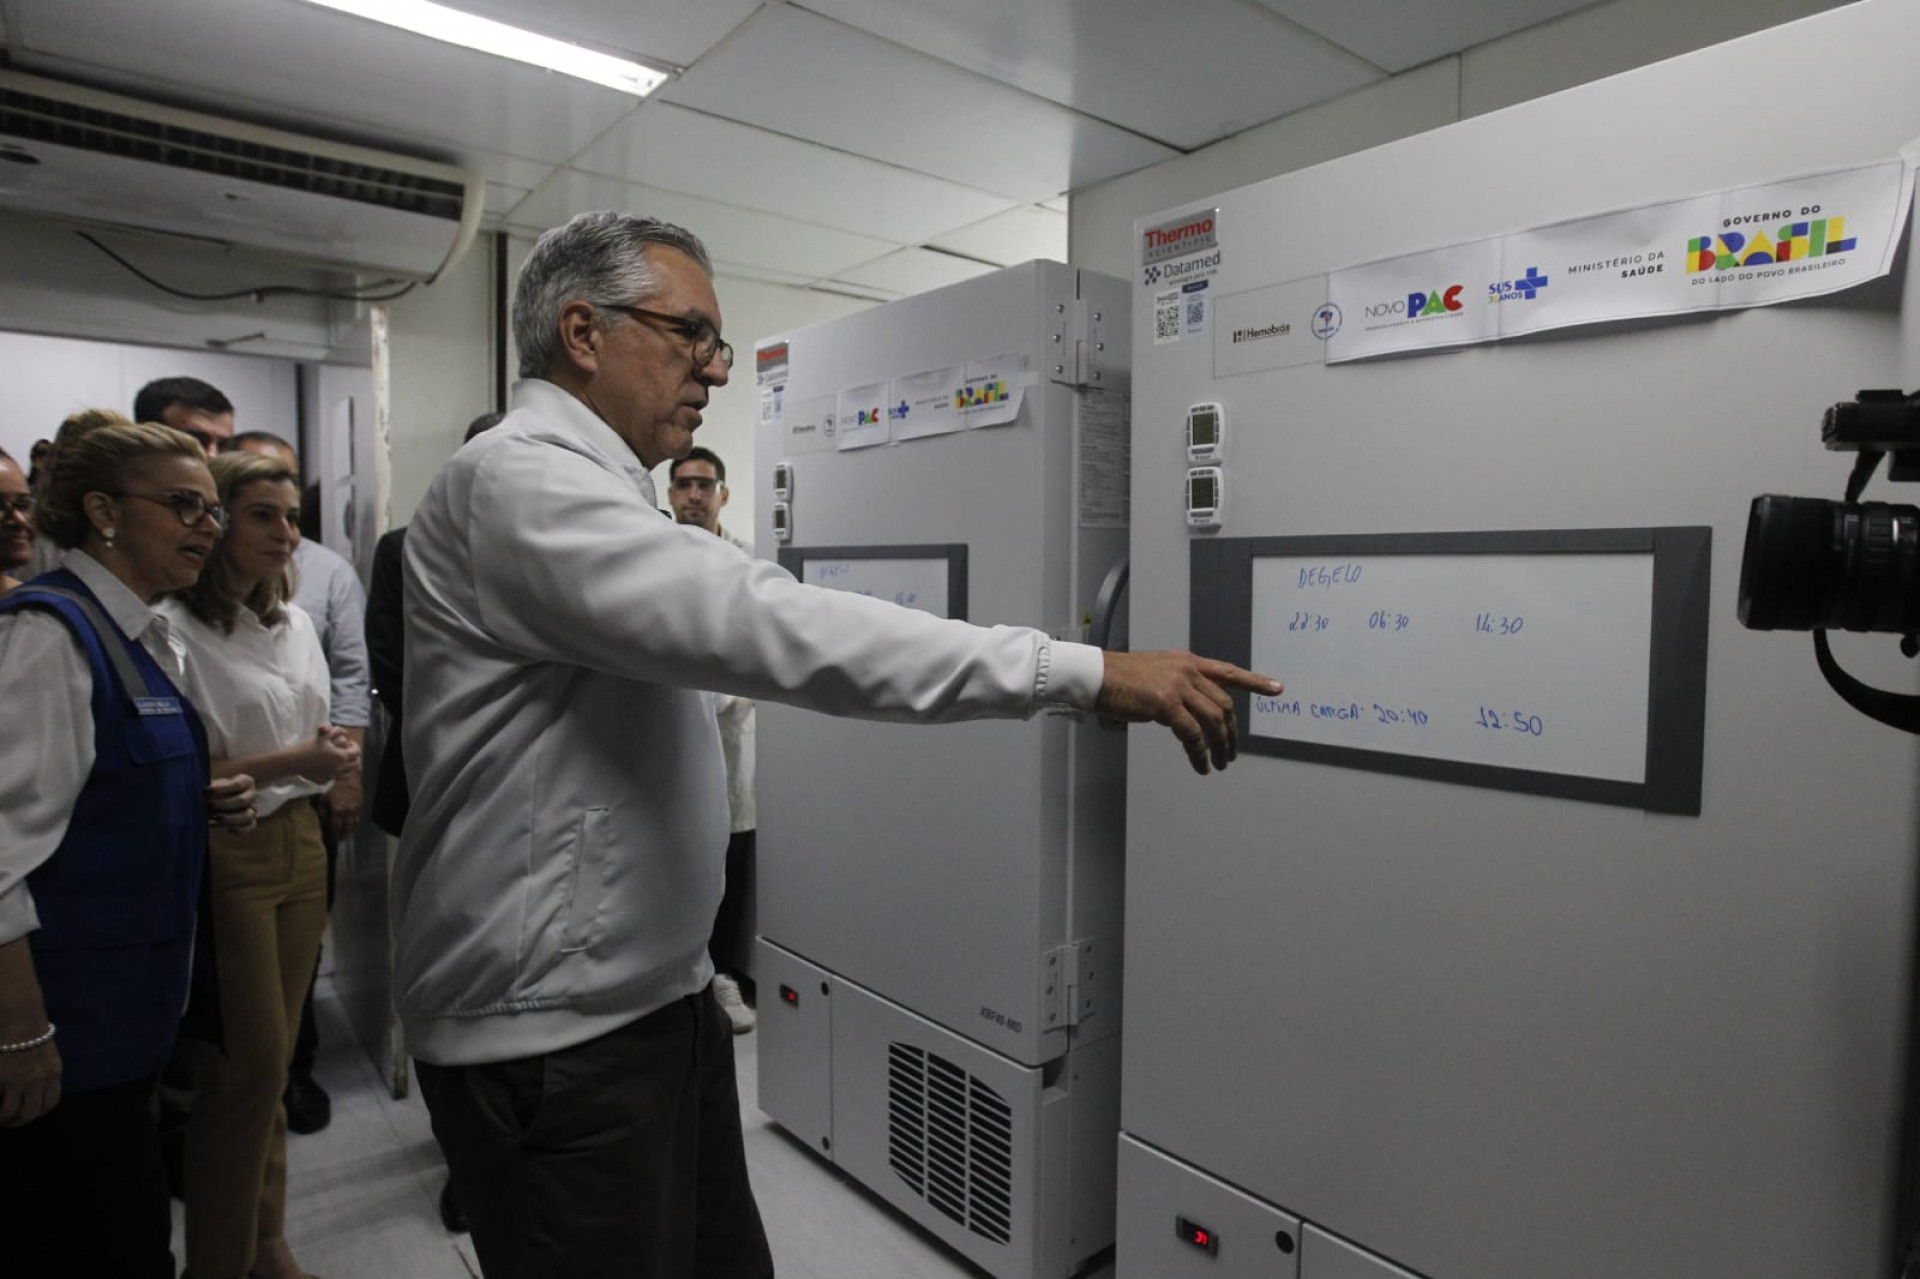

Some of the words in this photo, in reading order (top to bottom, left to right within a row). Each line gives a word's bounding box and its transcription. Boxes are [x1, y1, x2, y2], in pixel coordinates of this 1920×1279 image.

[1723, 209, 1792, 228] GOVERNO
[1800, 204, 1821, 216] DO
[1144, 219, 1214, 249] Thermo
[1686, 216, 1857, 274] BRASIL
[1163, 250, 1221, 279] Datamed
[1568, 254, 1643, 275] MINISTÉRIO
[1648, 250, 1665, 262] DA
[1621, 263, 1664, 279] SAÚDE
[1691, 277, 1706, 286] DO
[1709, 273, 1735, 284] LADO
[1738, 272, 1753, 281] DO
[1757, 269, 1784, 279] POVO
[1788, 258, 1846, 275] BRASILEIRO
[1488, 280, 1513, 296] SUS
[1364, 300, 1406, 319] NOVO
[1407, 284, 1464, 319] PAC
[858, 407, 880, 426] PAC
[1297, 563, 1363, 589] DEGELO
[1368, 610, 1410, 630] 06:30
